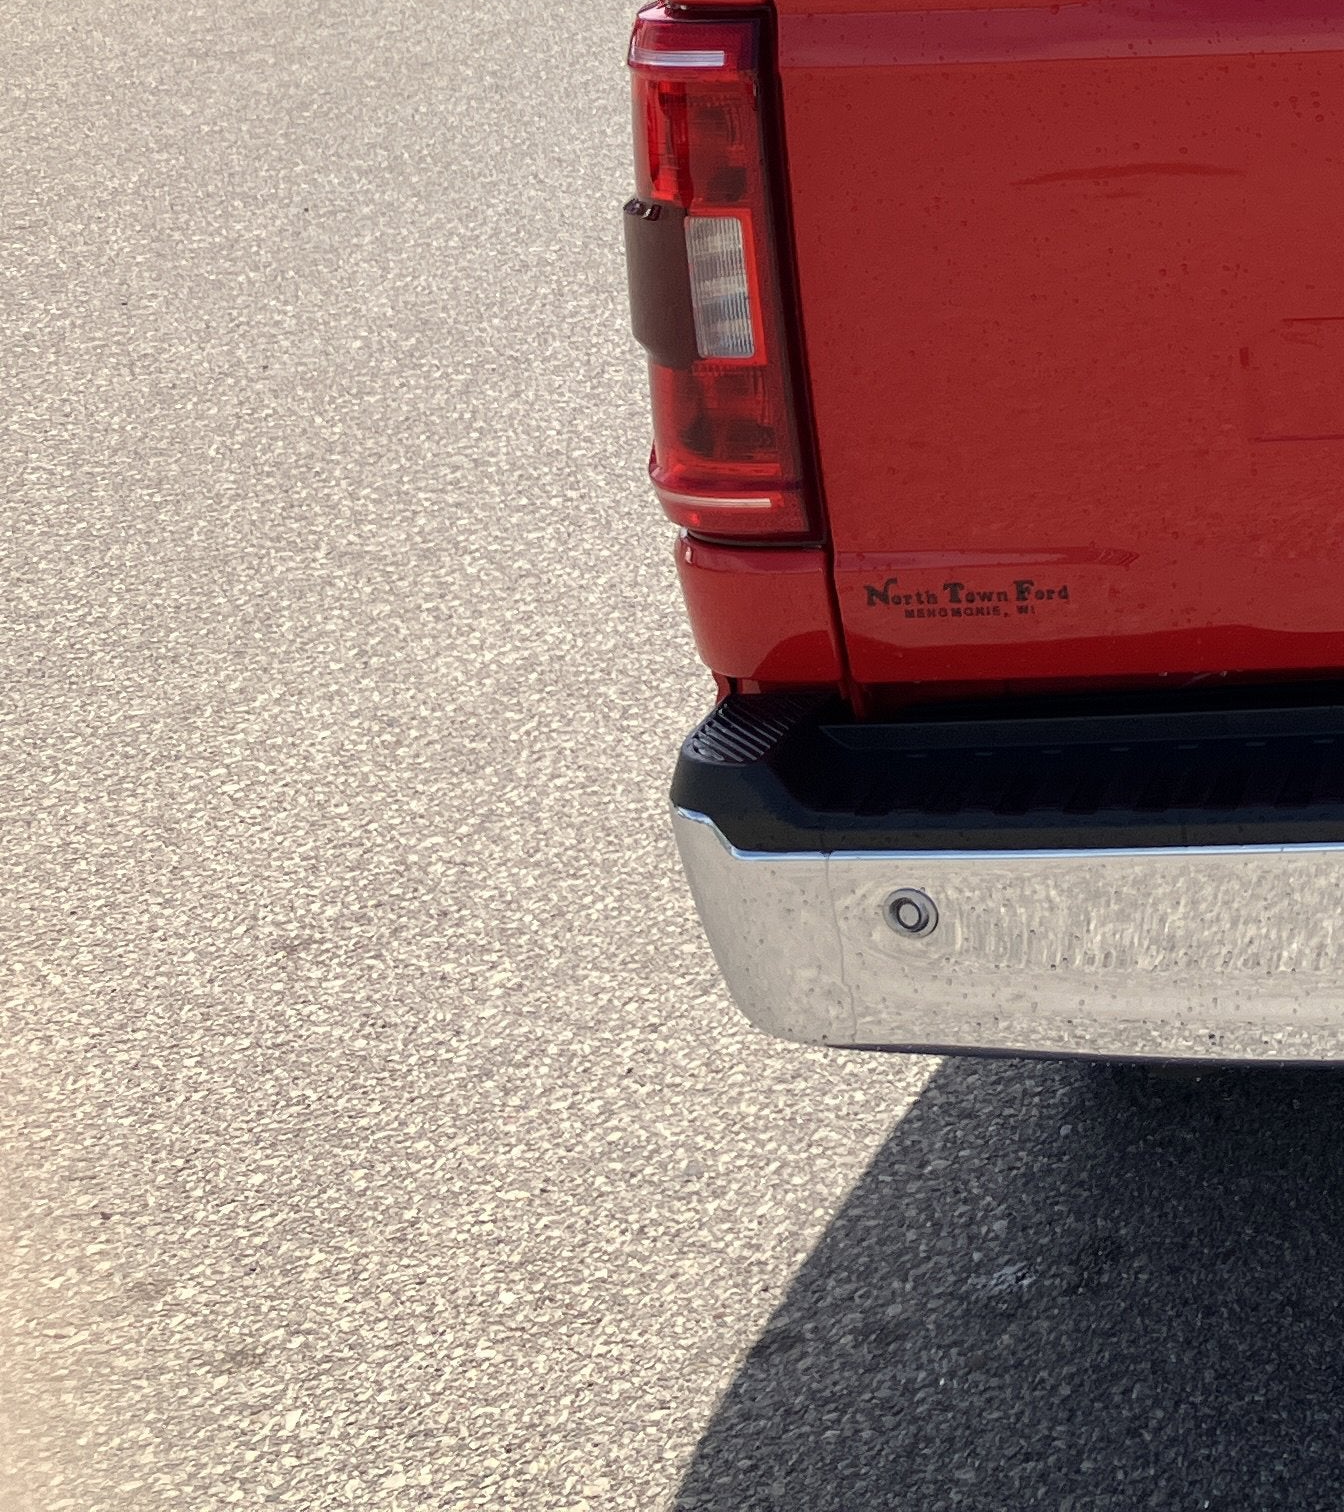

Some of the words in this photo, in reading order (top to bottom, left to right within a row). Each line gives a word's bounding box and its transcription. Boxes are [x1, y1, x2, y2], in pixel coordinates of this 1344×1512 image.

[864, 577, 938, 607] North
[942, 582, 1009, 605] Town
[1013, 579, 1070, 602] Ford
